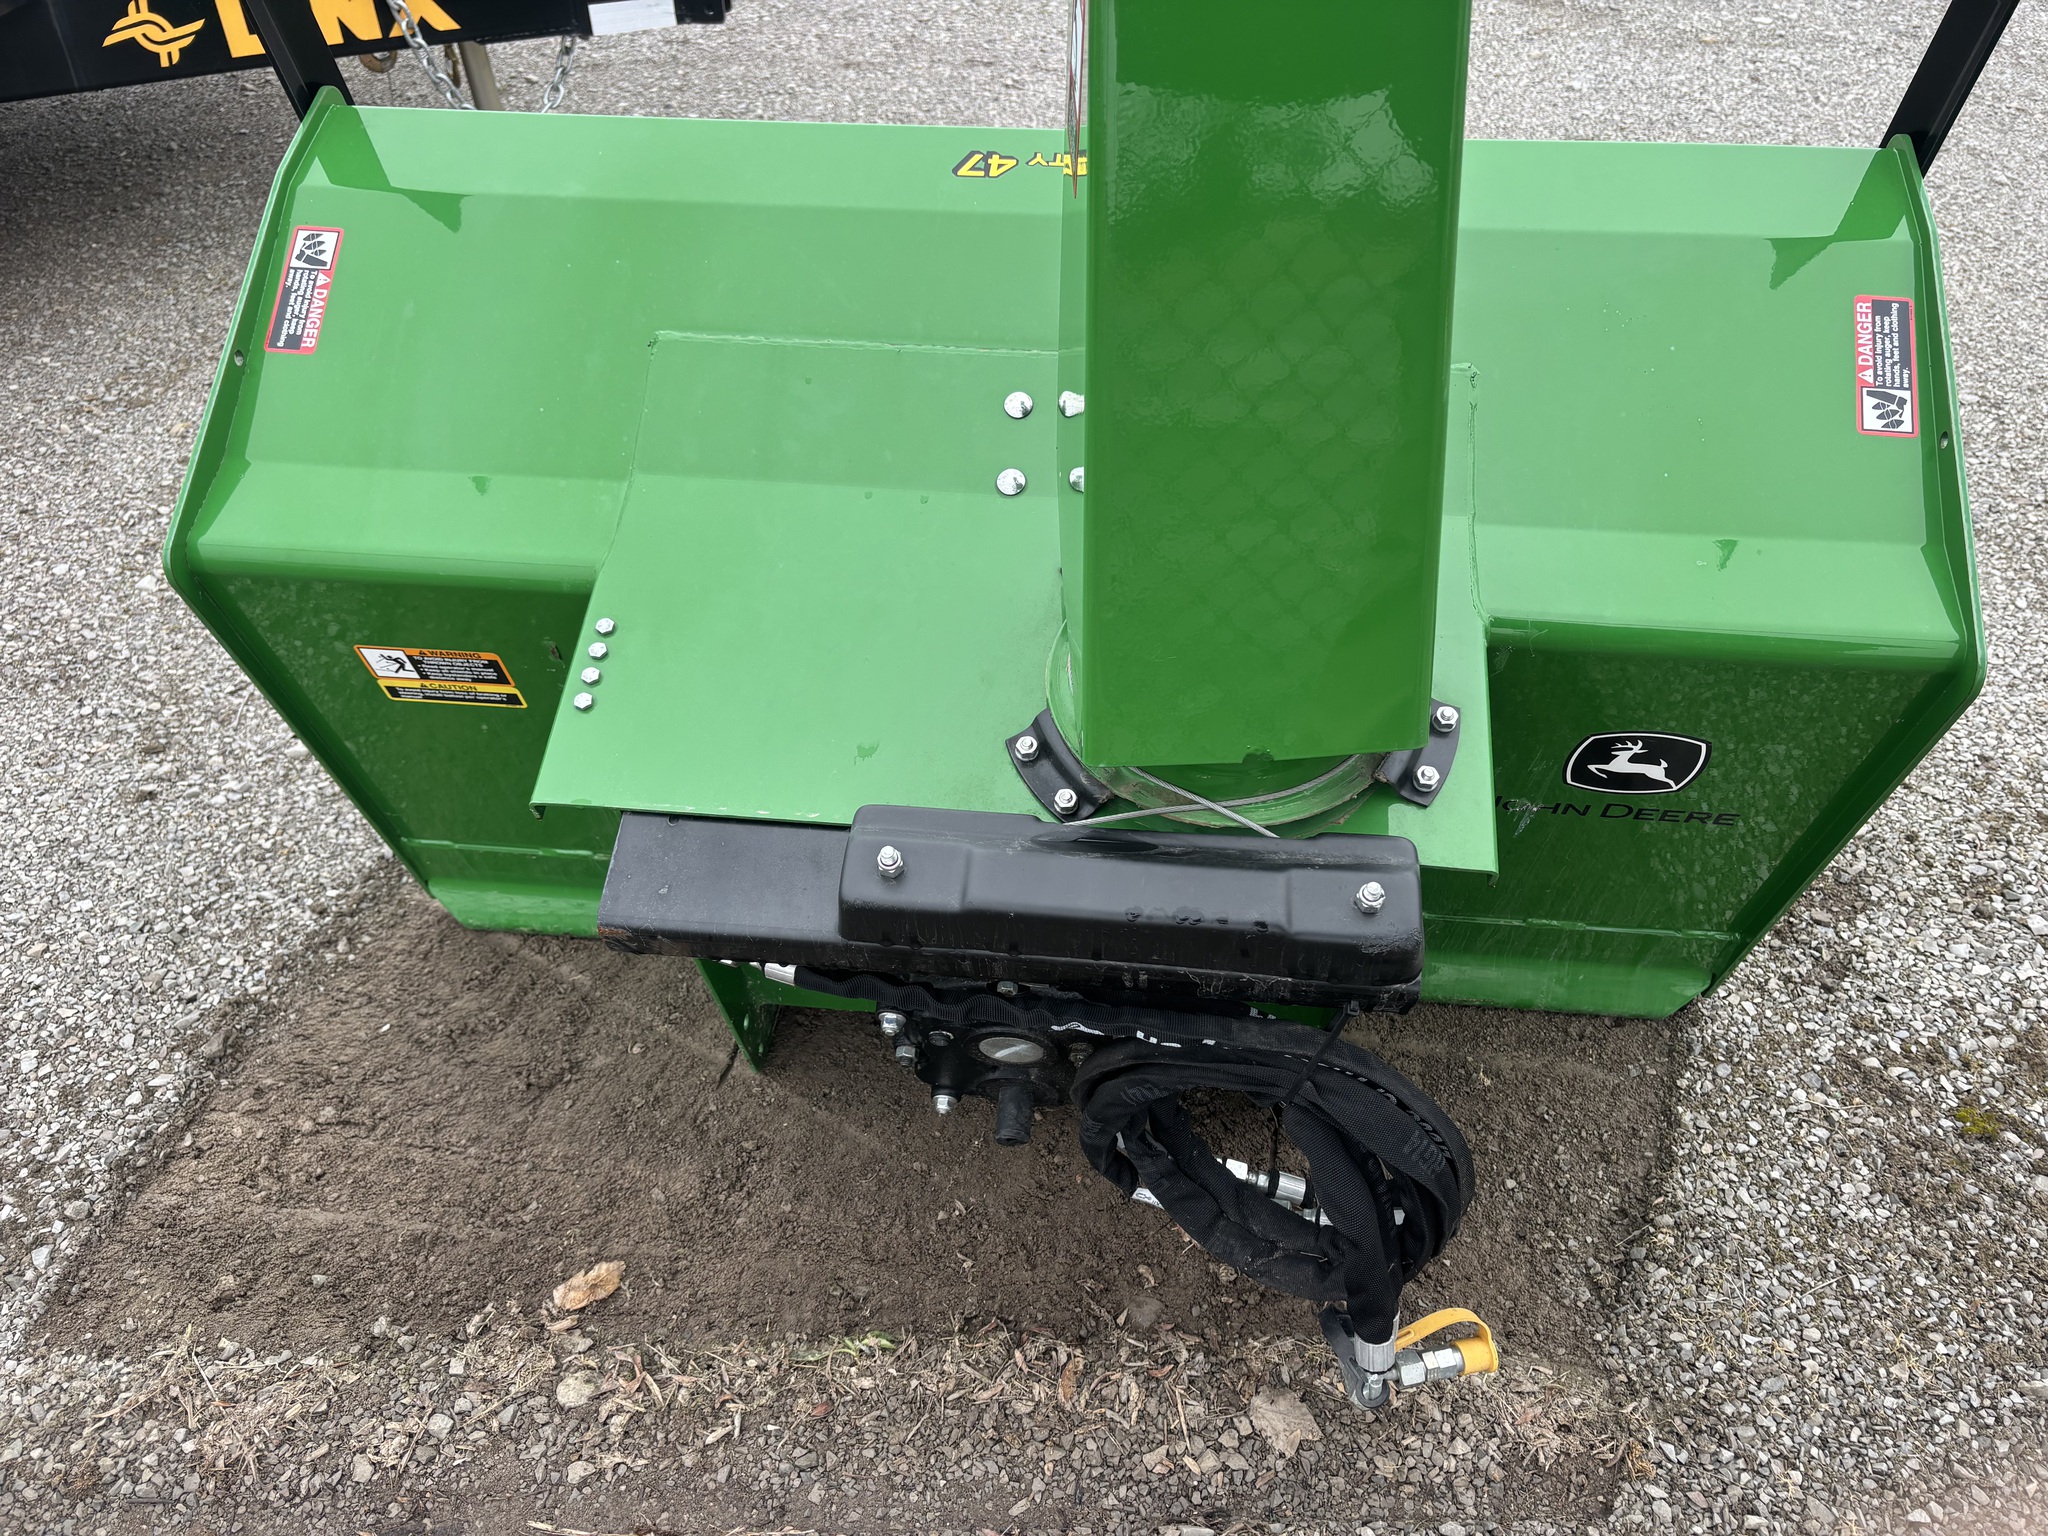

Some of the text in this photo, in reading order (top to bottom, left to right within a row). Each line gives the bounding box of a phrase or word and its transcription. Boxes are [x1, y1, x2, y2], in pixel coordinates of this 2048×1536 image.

[214, 0, 463, 58] LNX
[951, 150, 1019, 178] 47
[285, 269, 295, 288] away.
[297, 270, 310, 296] rotating
[289, 293, 298, 306] feet
[296, 270, 318, 335] To avoid injury from
[285, 306, 293, 319] and
[301, 288, 328, 348] DANGER
[1890, 302, 1899, 332] clothing
[277, 320, 290, 347] clothing
[288, 318, 298, 335] keep
[1856, 302, 1873, 366] DANGER
[1874, 315, 1883, 386] To avoid injury from
[1883, 316, 1893, 387] rotating auger, keep
[1892, 347, 1900, 362] feet
[1893, 363, 1901, 388] hands,
[1902, 367, 1911, 389] away.
[428, 650, 481, 659] WARNING
[430, 683, 478, 691] CAUTION
[1600, 803, 1741, 827] DEERE
